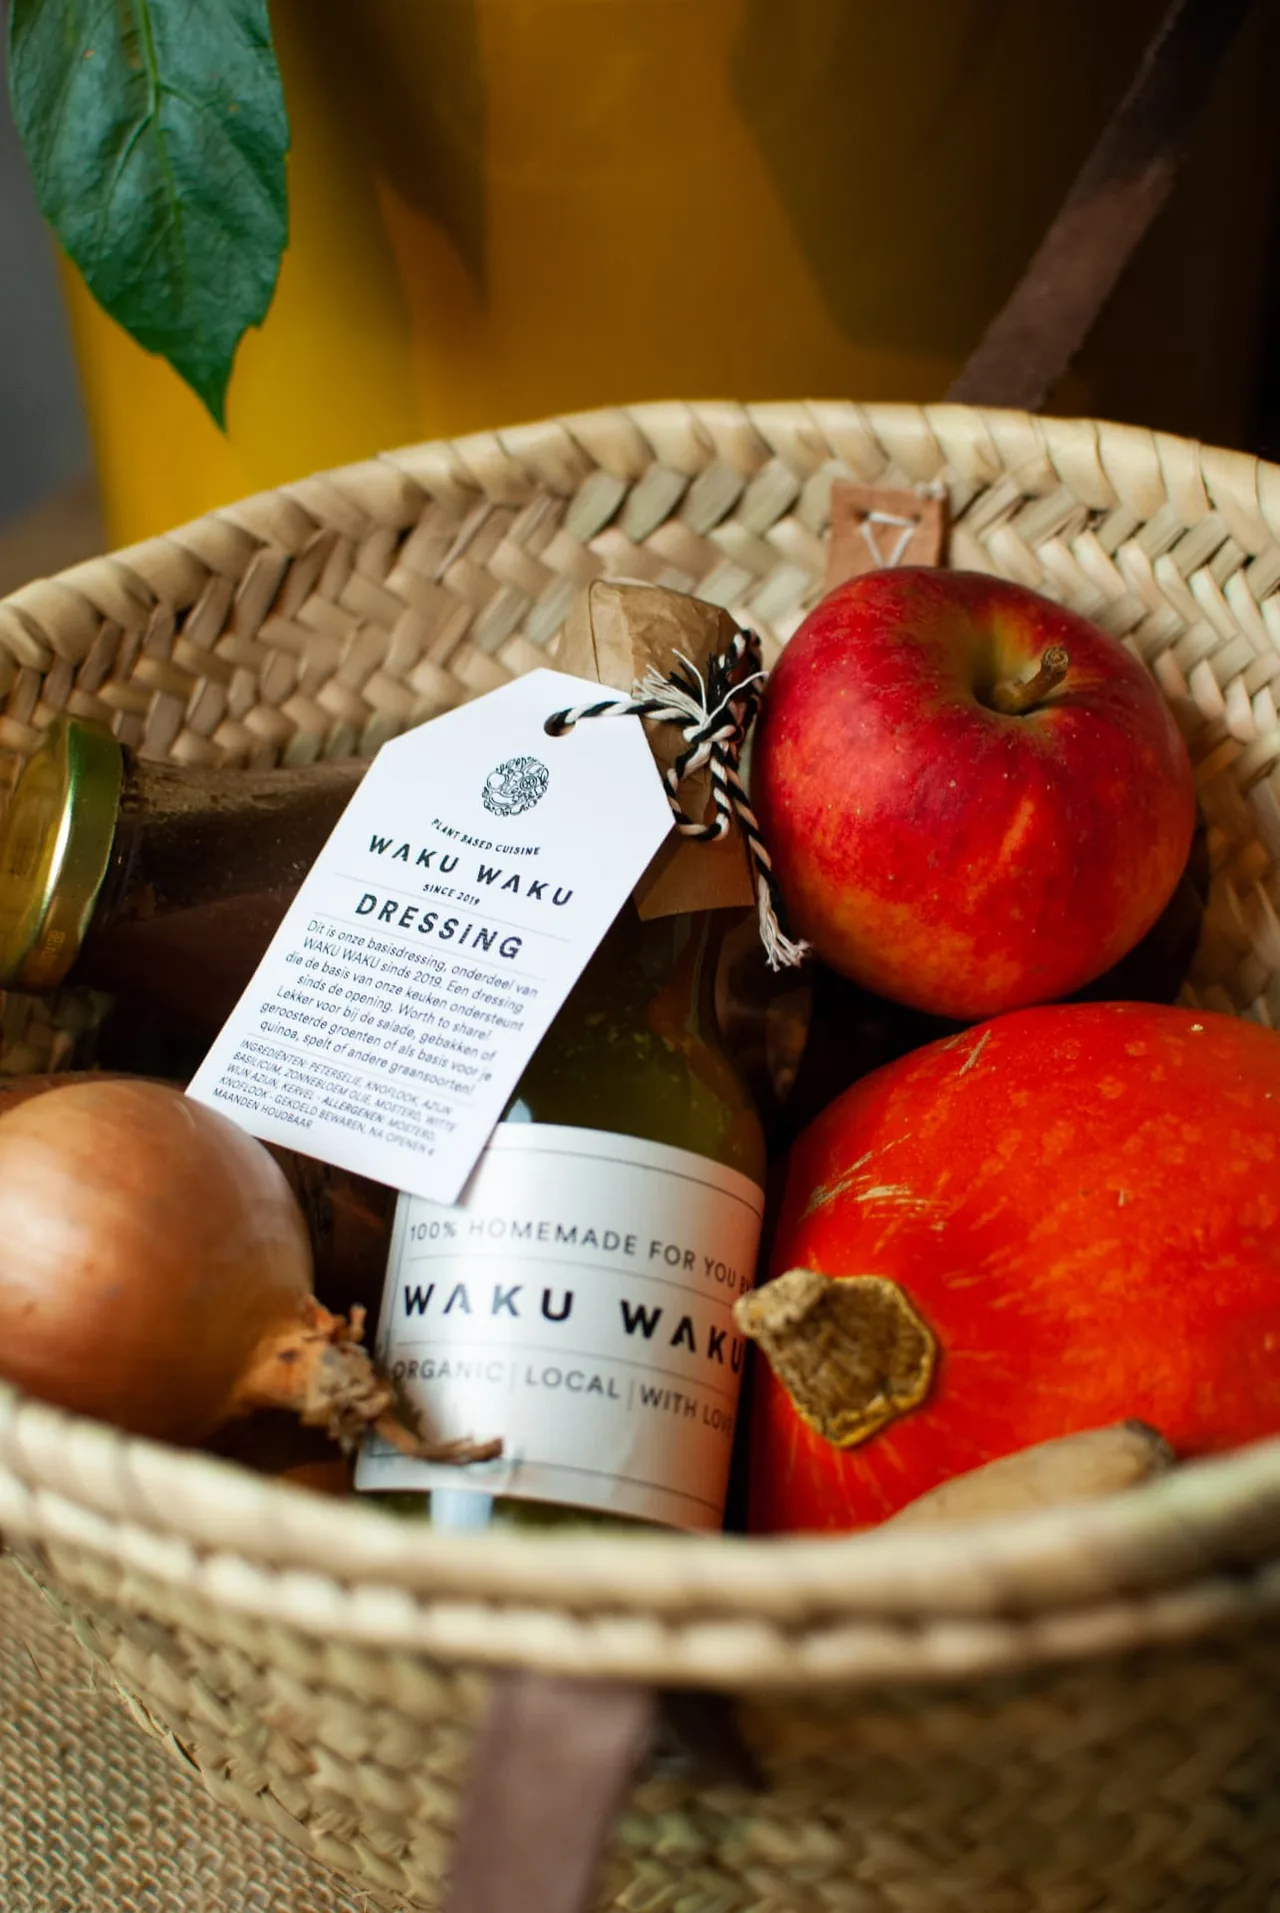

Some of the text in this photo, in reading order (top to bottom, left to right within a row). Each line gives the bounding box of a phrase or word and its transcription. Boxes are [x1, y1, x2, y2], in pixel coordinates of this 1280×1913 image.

[369, 834, 574, 907] WAKU WAKU
[431, 818, 541, 856] PLANT BASED CUISINE
[355, 893, 523, 960] DRESSING
[422, 884, 481, 906] SINCE 2019
[285, 951, 525, 1032] die de basis van onze keuken ondersteunt
[303, 937, 525, 1016] WAKU WAKU sinds 2019. Een dressing
[307, 919, 539, 997] Dit is onze basisdressing, onderdeel van
[276, 986, 498, 1062] Lekker voor bij de salade, gebakken of
[297, 974, 493, 1041] sinds de opening. Worth to share!
[259, 1002, 493, 1085] geroosterde groenten of als basis voor je
[260, 1021, 476, 1095] quinoa, spelt of andere graansoorten!
[213, 1087, 261, 1111] MAANDEN
[281, 1083, 313, 1101] KERVEL
[410, 1220, 458, 1242] 100%
[468, 1219, 639, 1256] HOMEMADE
[648, 1239, 696, 1271] FOR
[703, 1255, 736, 1288] YOU
[403, 1282, 745, 1375] WAKU WAKU
[393, 1357, 505, 1384] ORGANIC
[524, 1365, 622, 1399] LOCAL
[640, 1383, 697, 1419] WITH
